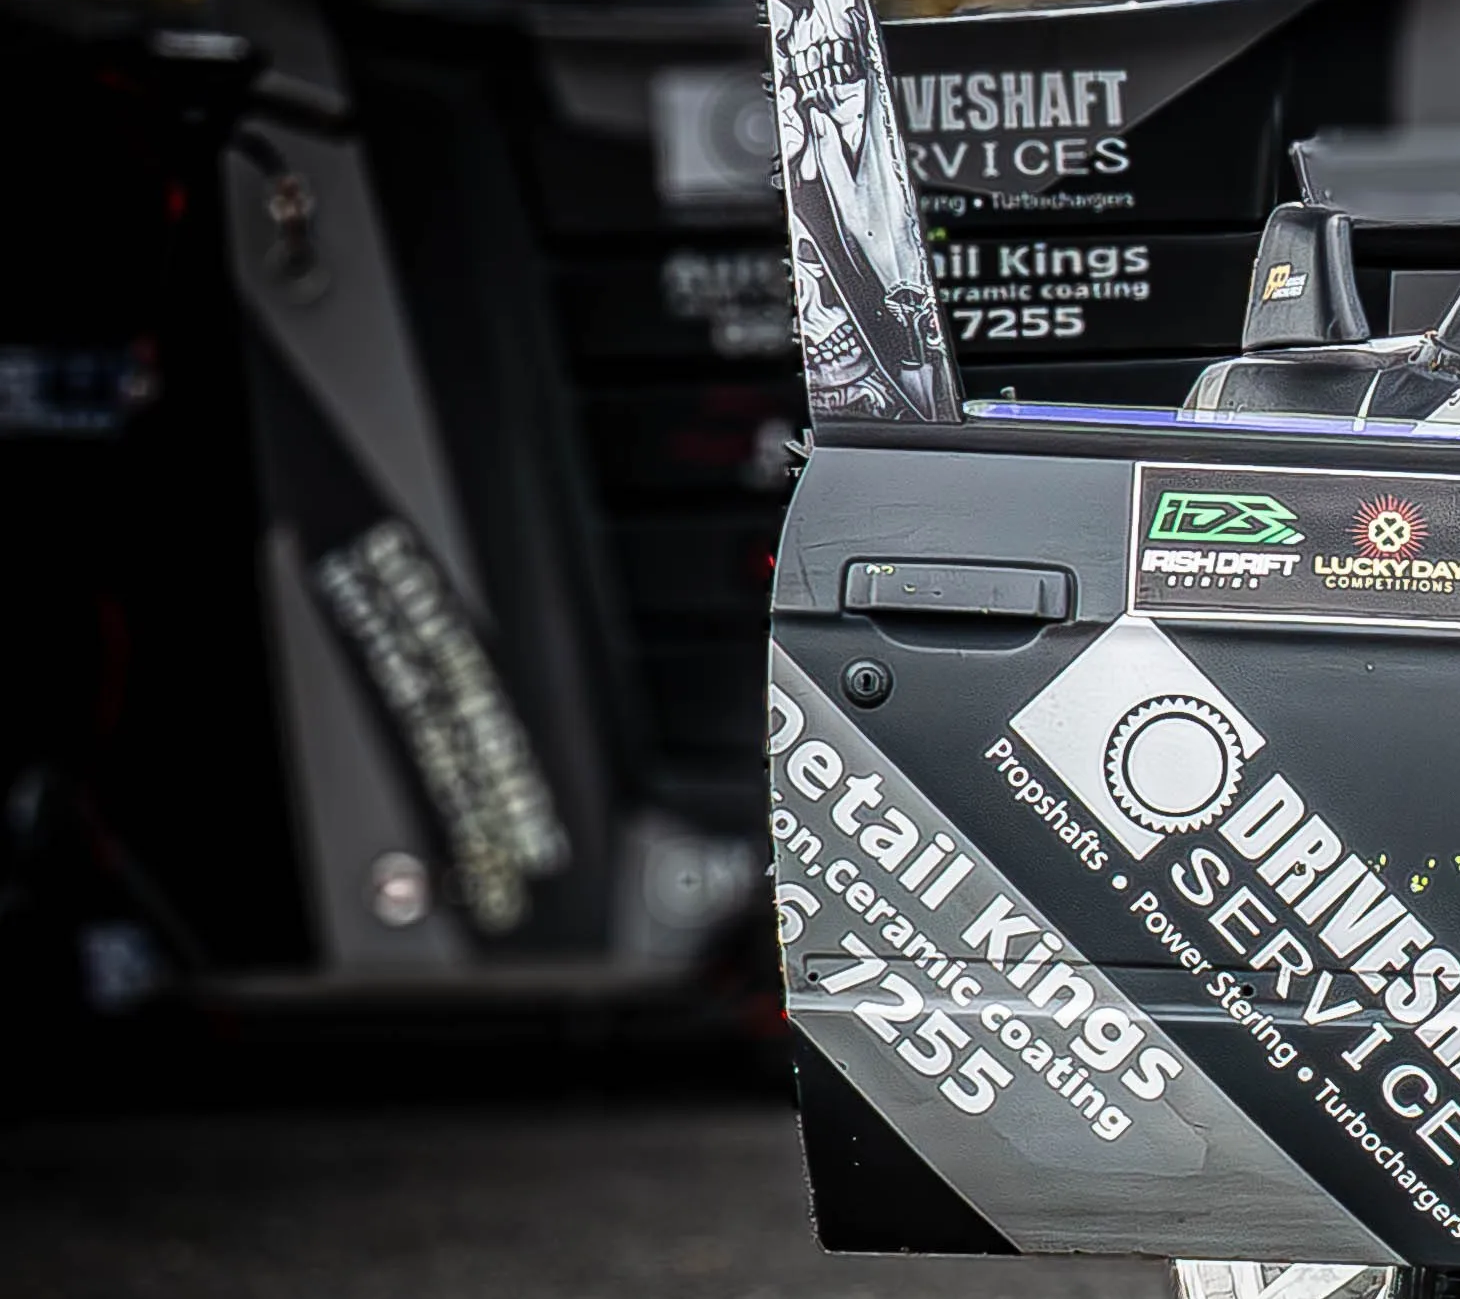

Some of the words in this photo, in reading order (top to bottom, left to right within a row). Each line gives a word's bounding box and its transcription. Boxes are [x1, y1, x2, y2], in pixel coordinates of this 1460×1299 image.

[894, 70, 1128, 131] VESHAFT
[907, 137, 1131, 180] RVICES
[1000, 243, 1150, 278] Kings
[940, 283, 1034, 302] eramic
[1040, 282, 1151, 301] coating
[953, 306, 1086, 340] 7255
[1141, 549, 1214, 575] IRISH
[1215, 551, 1301, 577] DRIFT
[1314, 555, 1412, 578] LUCKY
[1325, 577, 1456, 593] COMPETITIONS
[984, 736, 1109, 872] Propshafts
[1129, 889, 1213, 977] Power
[1205, 970, 1300, 1070] Stering
[960, 894, 1184, 1100] Kings
[819, 931, 1015, 1115] 7255
[979, 1001, 1132, 1142] coating
